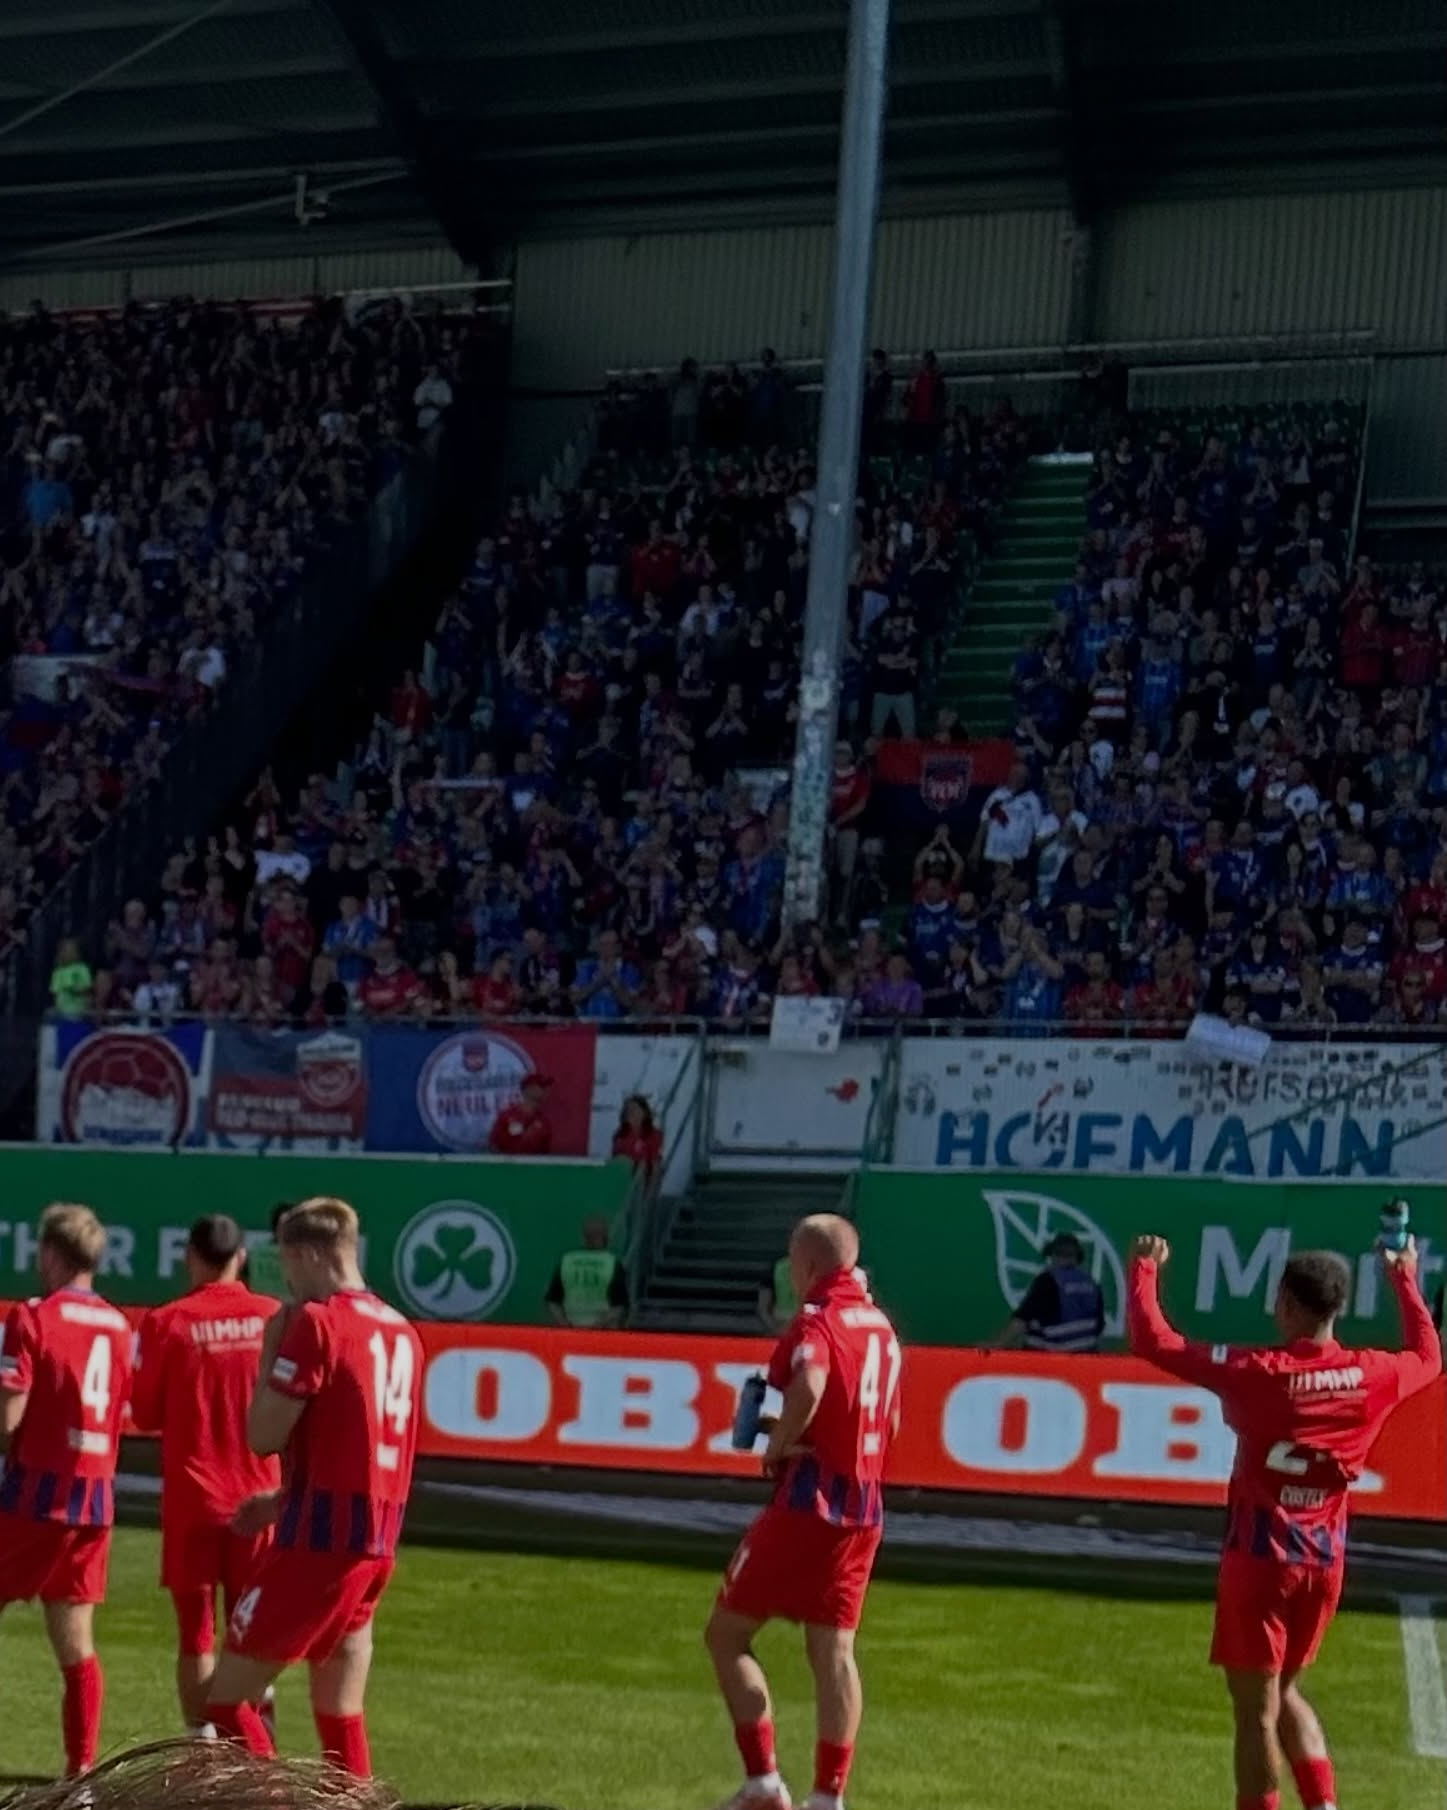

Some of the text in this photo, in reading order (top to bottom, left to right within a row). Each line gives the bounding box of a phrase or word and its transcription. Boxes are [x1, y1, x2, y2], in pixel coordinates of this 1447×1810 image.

[935, 1109, 1395, 1177] HOFMANN
[81, 1333, 112, 1424] 4
[368, 1329, 414, 1436] 14
